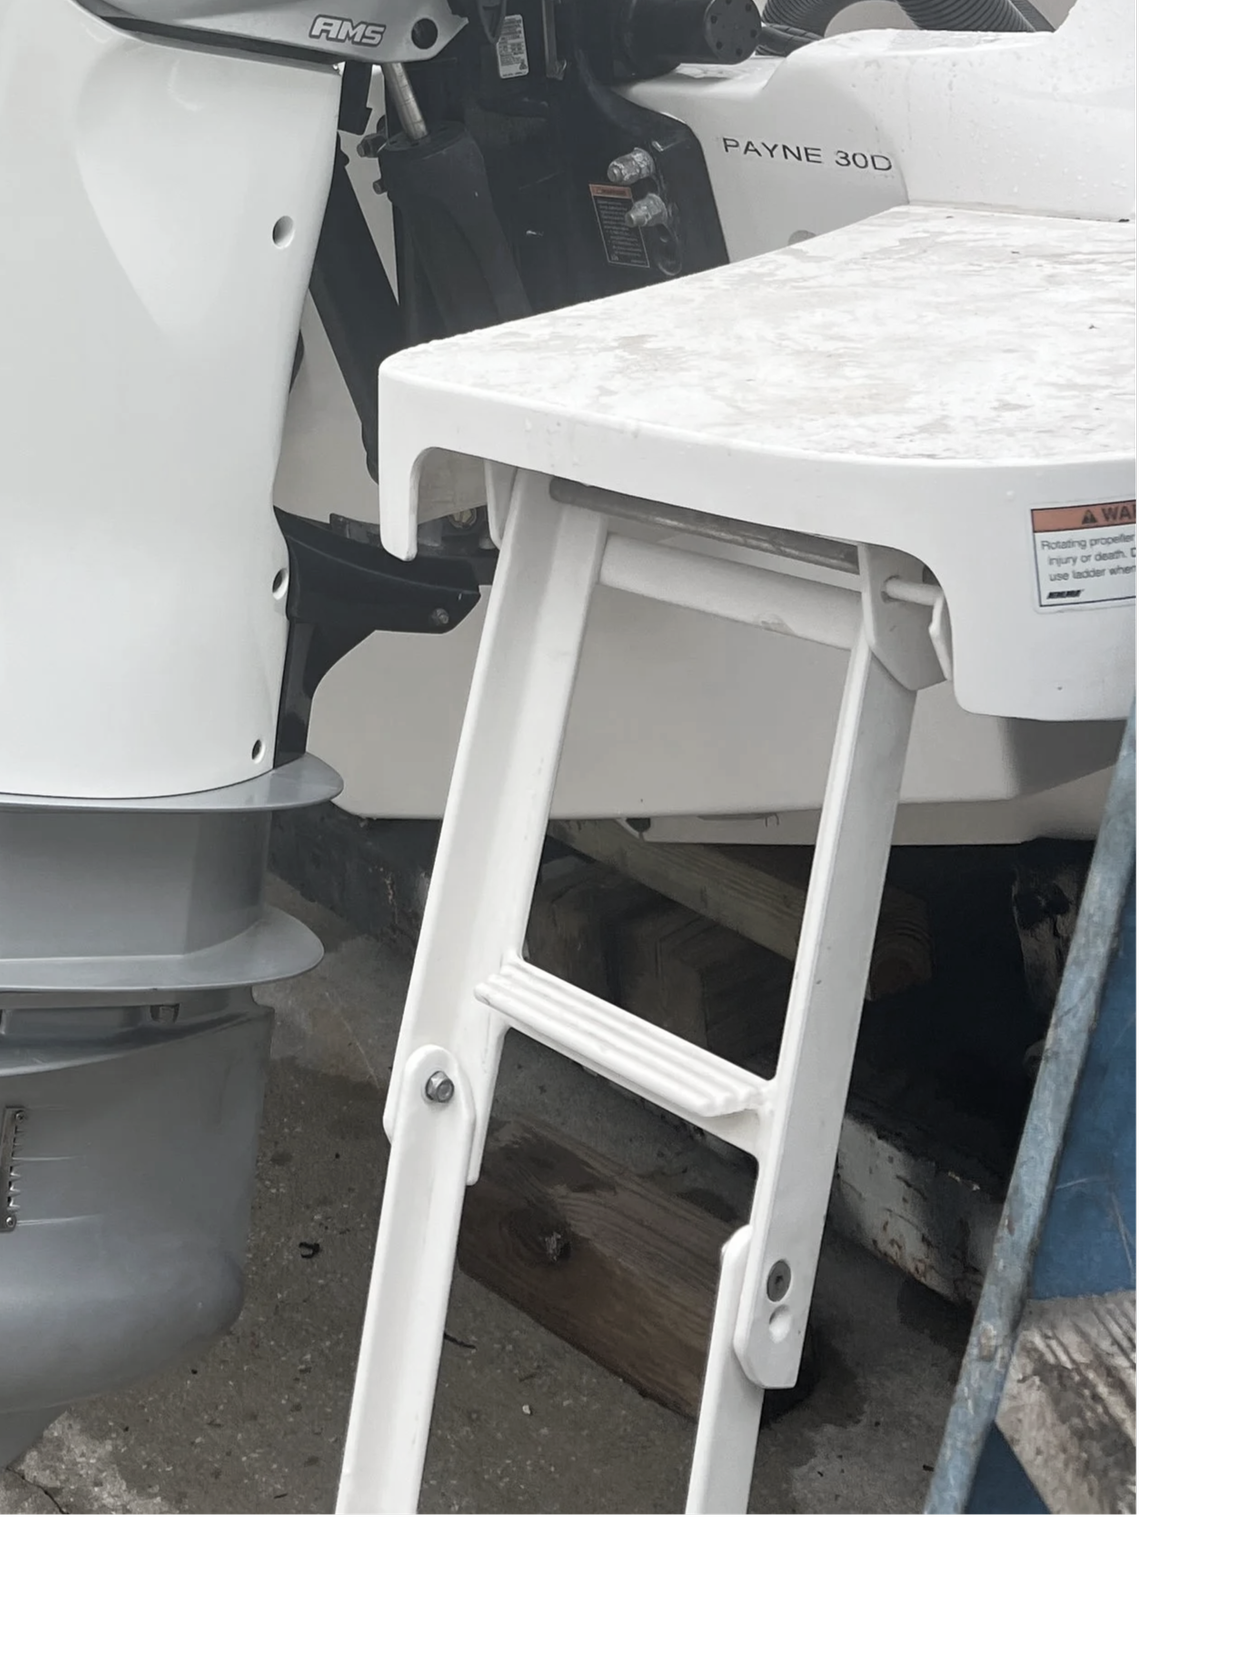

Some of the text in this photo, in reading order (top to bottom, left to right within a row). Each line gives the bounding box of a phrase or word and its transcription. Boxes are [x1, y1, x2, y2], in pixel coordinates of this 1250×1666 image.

[309, 14, 387, 47] AMS
[722, 137, 892, 171] PAYNE 30D
[1101, 504, 1137, 522] WA
[1041, 533, 1135, 550] Rotating propeller
[1048, 555, 1078, 567] injury
[1080, 555, 1092, 563] or
[1048, 572, 1069, 581] use
[1072, 568, 1106, 579] ladder
